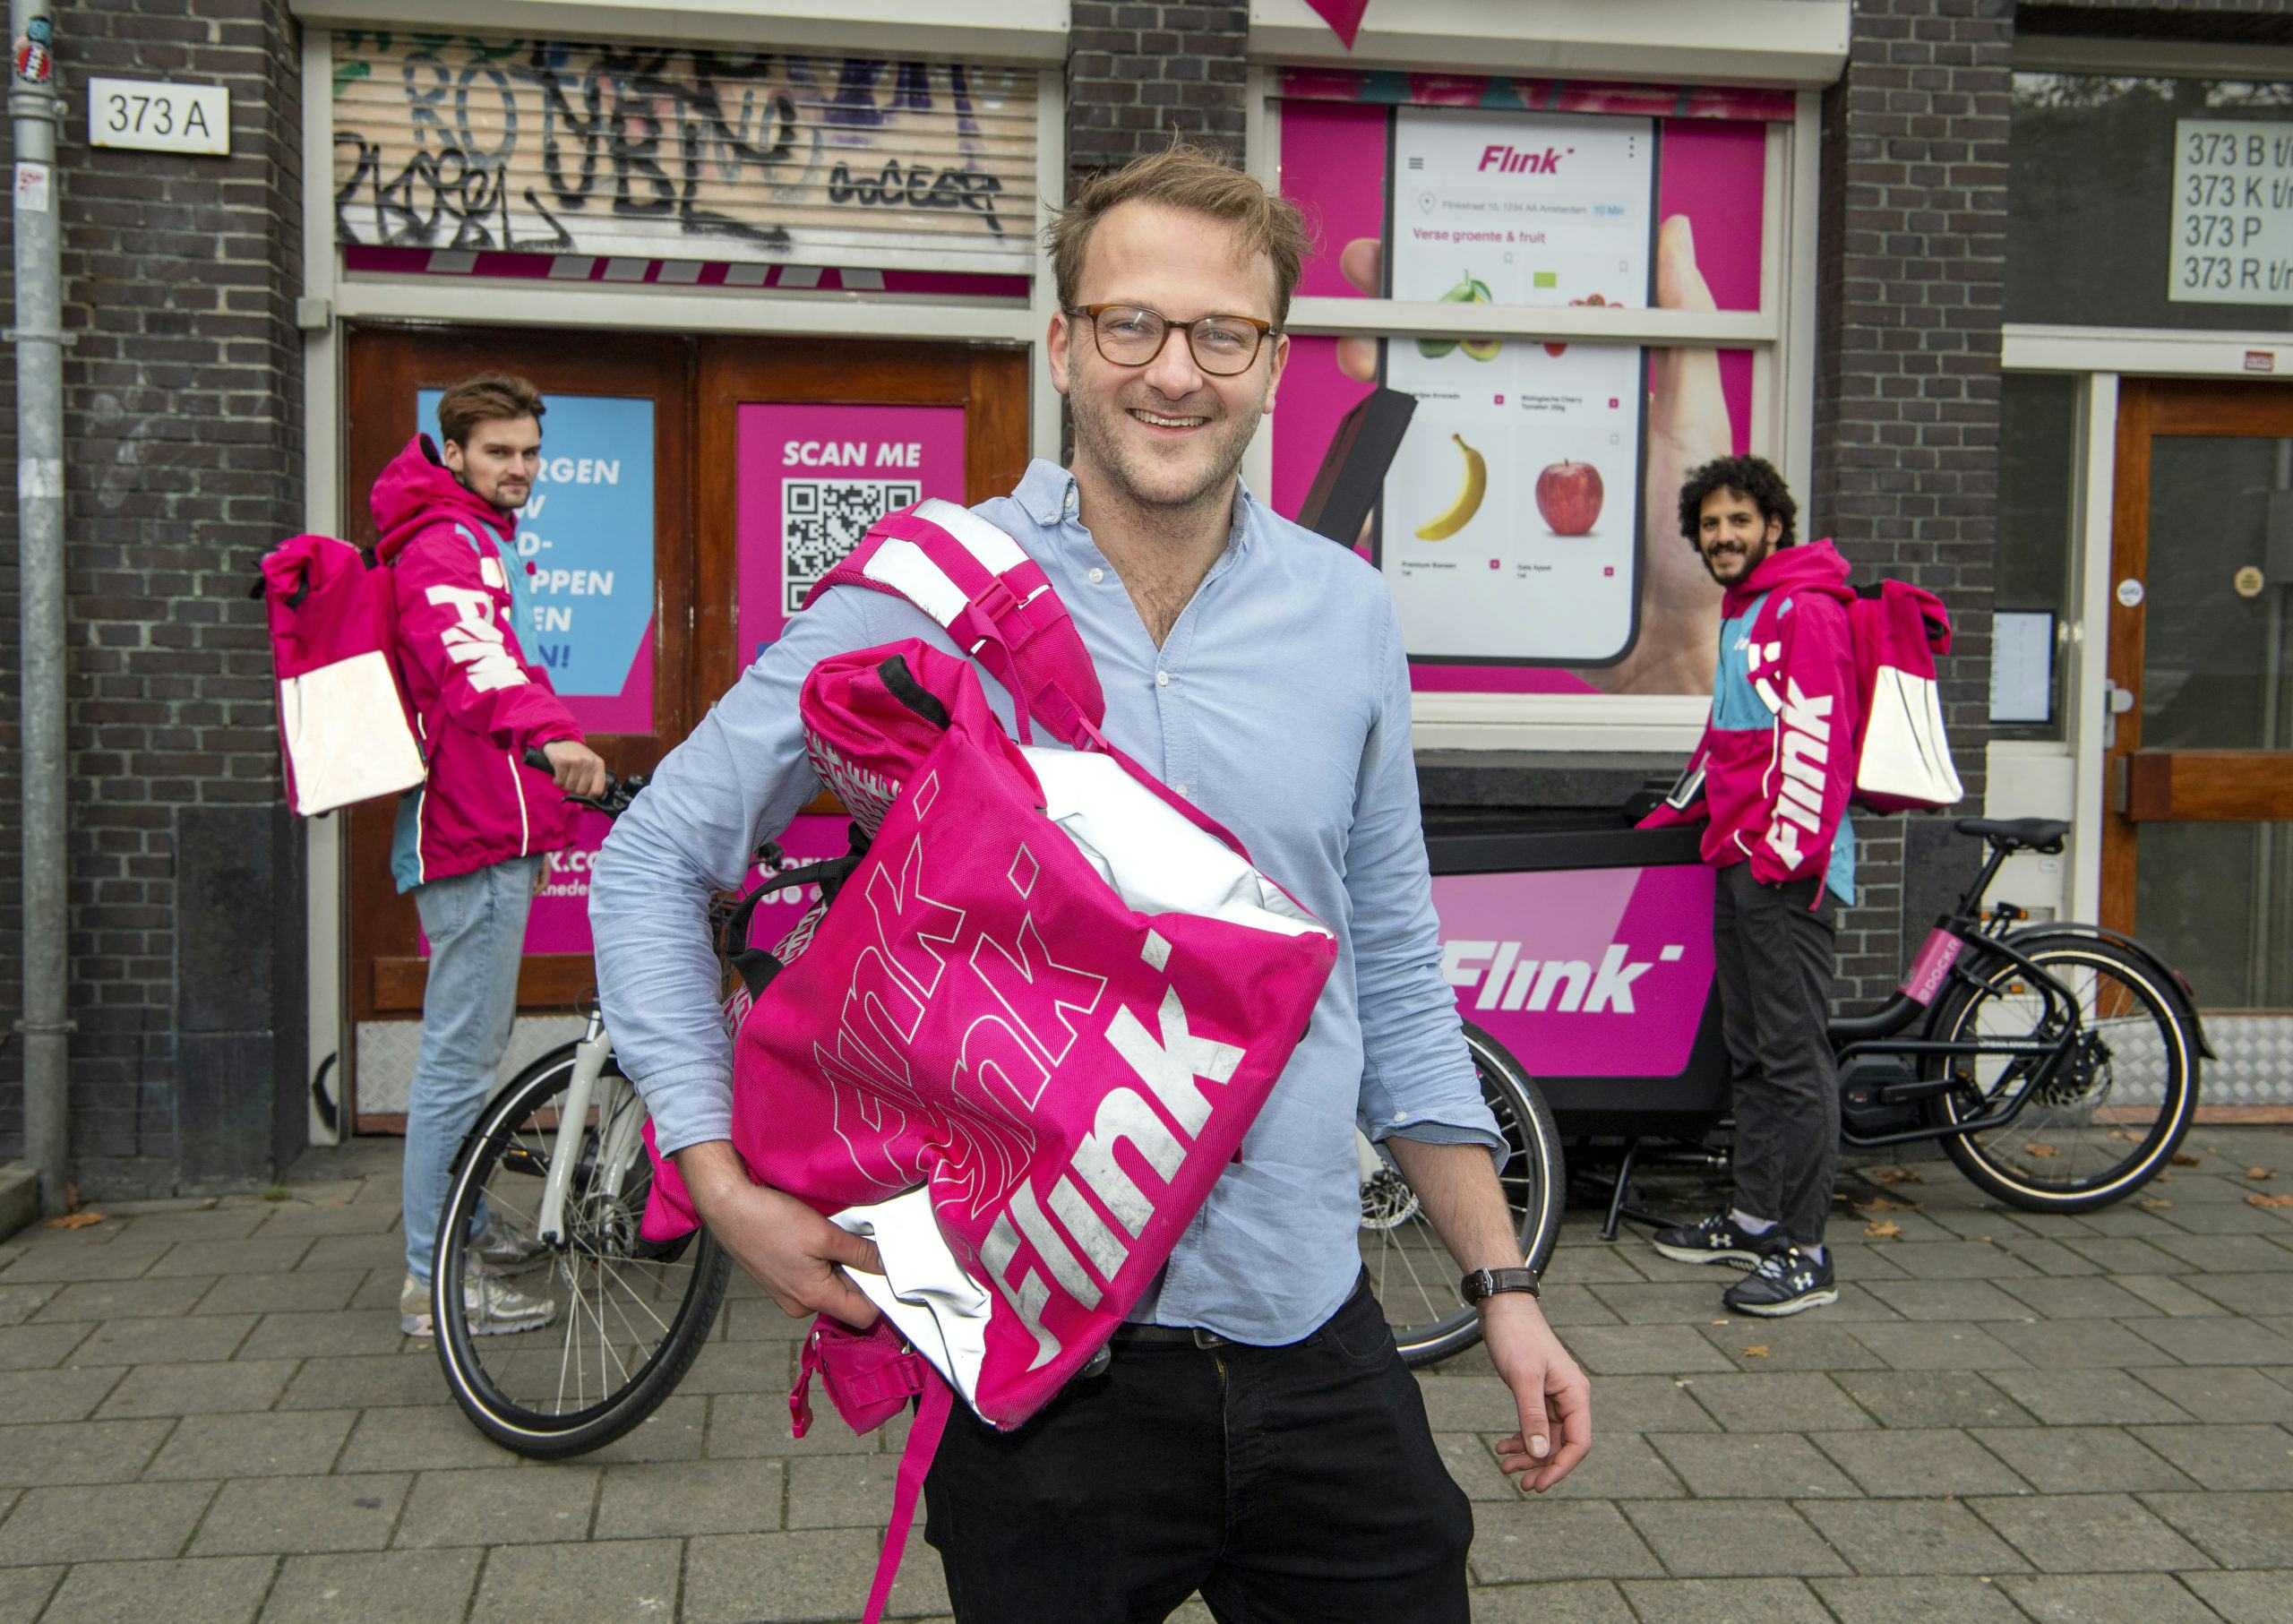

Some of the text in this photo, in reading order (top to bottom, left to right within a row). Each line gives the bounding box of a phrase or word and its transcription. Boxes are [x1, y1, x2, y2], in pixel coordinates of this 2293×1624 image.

[108, 95, 210, 139] 373 A
[1478, 145, 1562, 175] Flink
[2186, 133, 2293, 168] 373 B t/
[2186, 175, 2237, 208] 373
[2244, 176, 2263, 209] K
[1413, 228, 1546, 244] Verse groente & fruit
[2184, 215, 2263, 248] 373 P
[2183, 256, 2233, 289] 373
[2239, 258, 2260, 289] R
[782, 441, 923, 468] SCAN ME
[537, 458, 621, 485] RGEN
[530, 570, 614, 596] PPEN
[1765, 676, 1833, 871] Flink
[1441, 940, 1654, 1014] Flink
[980, 984, 1246, 1371] Flink
